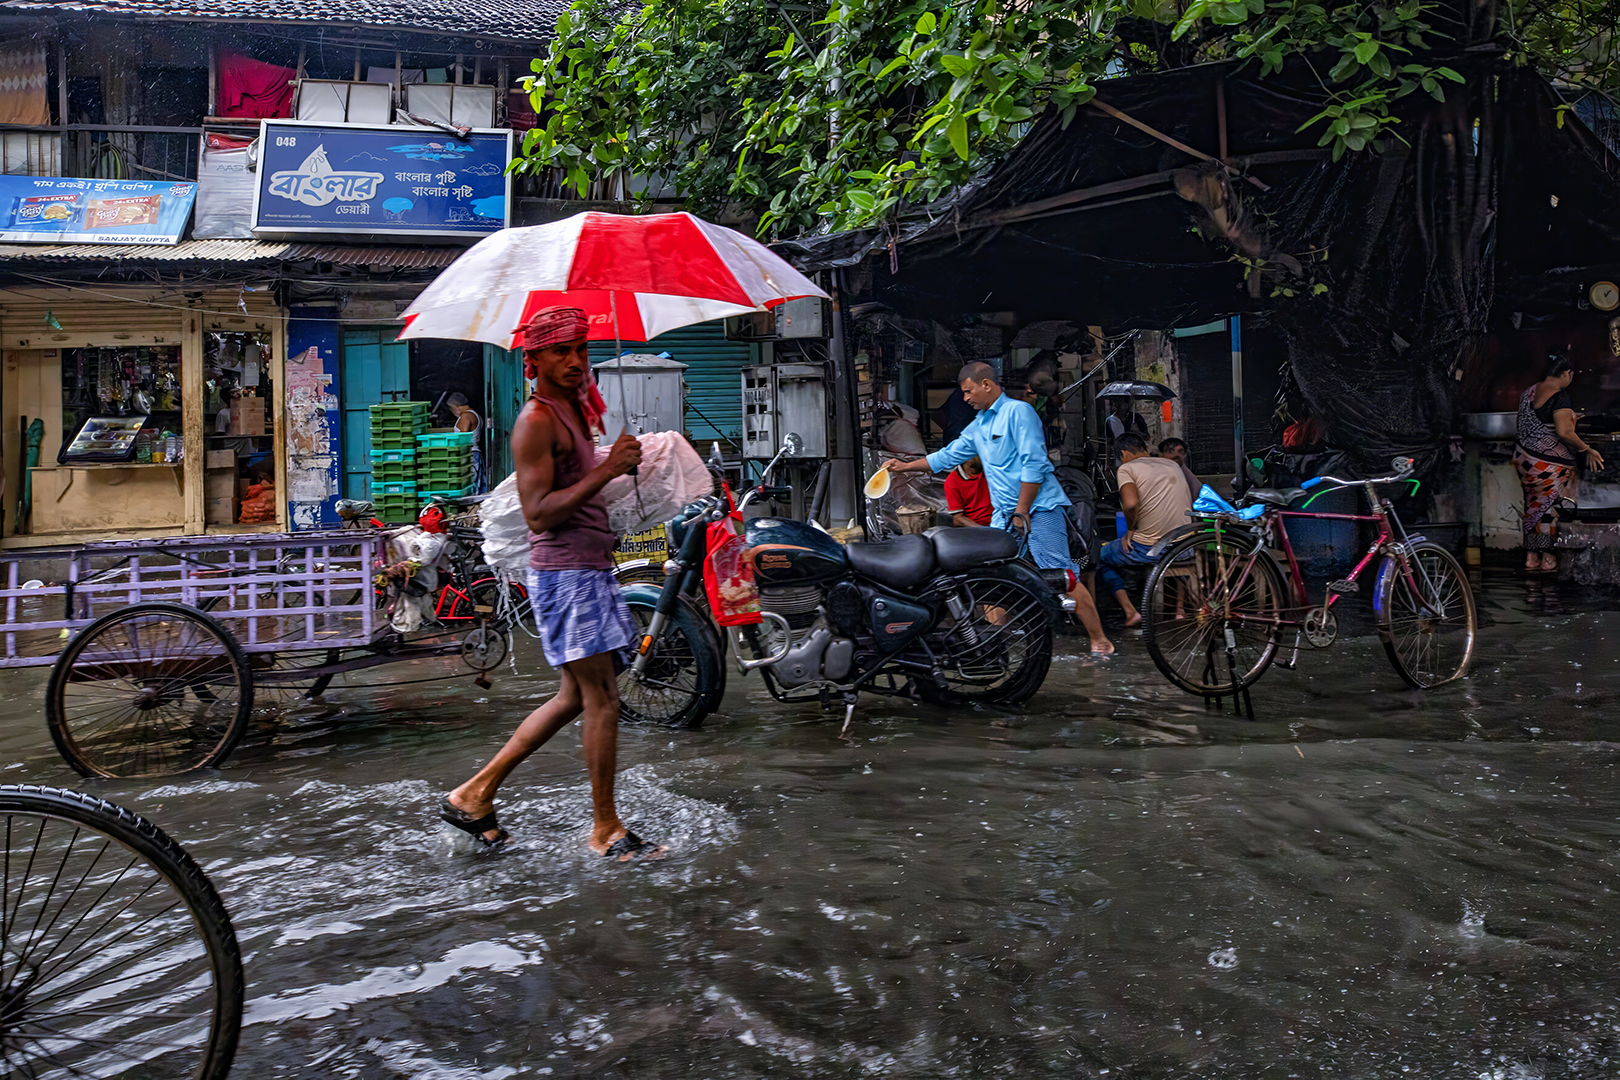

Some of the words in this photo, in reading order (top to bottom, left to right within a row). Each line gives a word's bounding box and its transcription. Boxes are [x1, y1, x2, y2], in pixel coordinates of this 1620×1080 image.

[276, 136, 296, 148] 048
[395, 171, 432, 183] বাংলার
[435, 169, 457, 186] পুষ্টি
[169, 184, 194, 192] Good
[271, 172, 382, 203] বাংলার
[412, 185, 448, 198] বাংলার
[452, 183, 474, 202] সৃষ্টি
[335, 202, 370, 216] ডেয়ারী
[97, 235, 137, 243] SANJAY
[587, 311, 615, 325] ral
